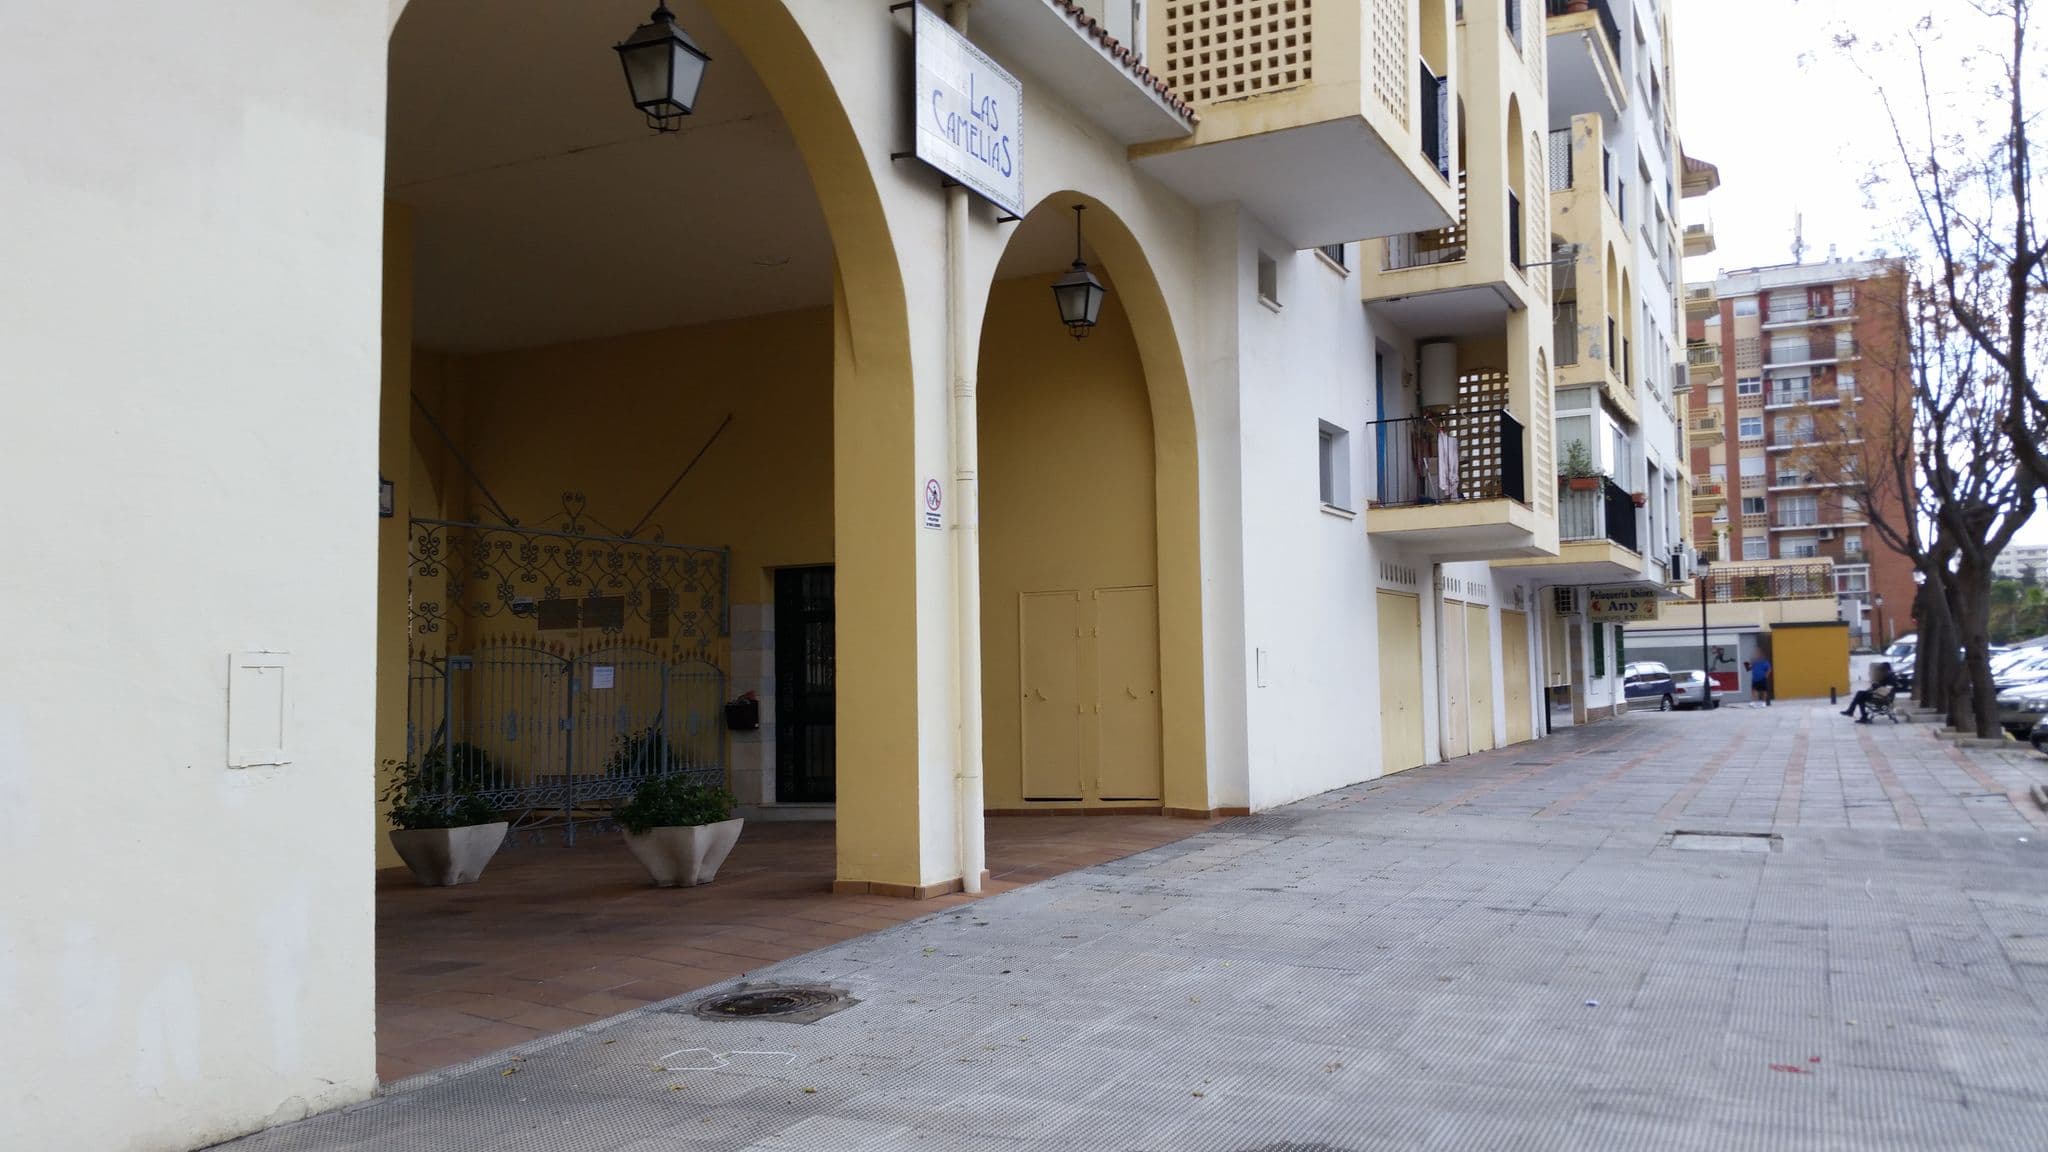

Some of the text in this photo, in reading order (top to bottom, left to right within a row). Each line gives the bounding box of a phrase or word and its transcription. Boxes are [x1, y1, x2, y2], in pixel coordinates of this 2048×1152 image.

[970, 73, 999, 132] LAS
[932, 89, 1012, 178] CAMELIAS
[1608, 601, 1638, 612] Any
